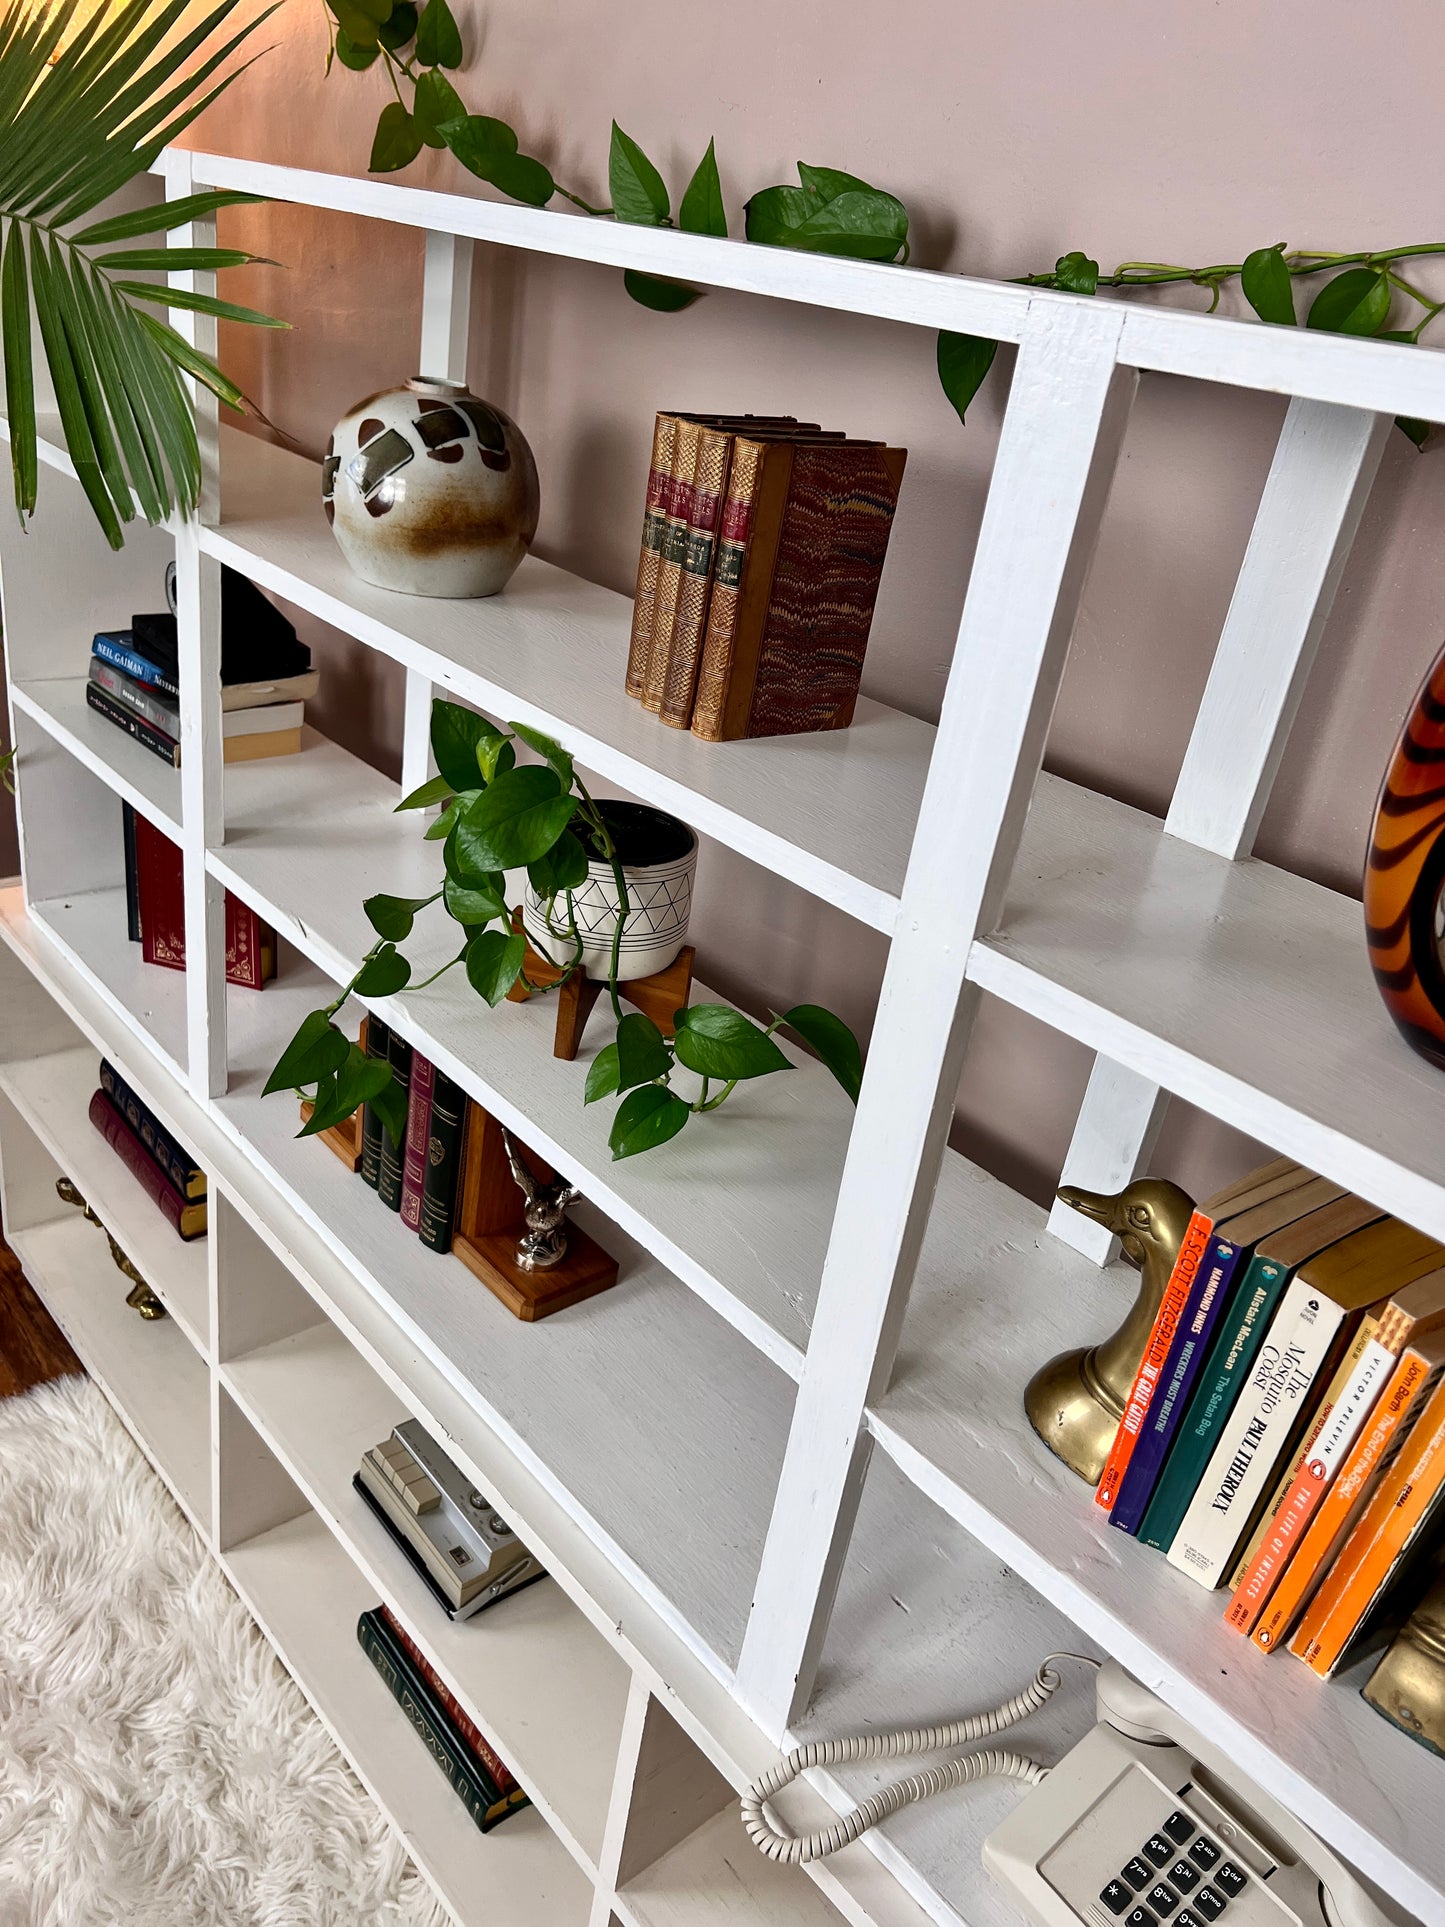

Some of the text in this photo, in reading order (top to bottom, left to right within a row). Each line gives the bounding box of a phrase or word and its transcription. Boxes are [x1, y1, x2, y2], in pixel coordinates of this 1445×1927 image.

[97, 642, 113, 659] NEIL
[115, 653, 143, 675] GAIMAN
[1123, 1227, 1207, 1436] F. SCOTT FITZGERALD THE GREAT GATSBY
[1154, 1267, 1223, 1433] HAMMOND INNES WRECKERS MUST BREATHE
[1195, 1286, 1267, 1436] Alistair MacLean The Satan Bug
[1253, 1345, 1280, 1391] Coast
[1261, 1341, 1306, 1414] Mosquito
[1402, 1362, 1422, 1387] John
[1285, 1368, 1313, 1399] The
[1353, 1358, 1380, 1401] VICTOR
[1388, 1385, 1410, 1412] Barth
[1324, 1406, 1353, 1455] PELEVIN
[1381, 1412, 1395, 1431] The
[1368, 1428, 1385, 1448] End
[1364, 1446, 1375, 1459] of
[1211, 1416, 1267, 1515] PAUL THEROUX
[1355, 1456, 1369, 1475] the
[1395, 1484, 1413, 1508] EMMA
[1247, 1487, 1311, 1599] THE LIFE OF INSECTS
[1170, 1815, 1178, 1824] 1
[1150, 1840, 1169, 1854] 4 ghi
[1194, 1841, 1216, 1858] 2 abc
[1129, 1861, 1147, 1877] 7 prs
[1174, 1864, 1193, 1879] 5 jkl
[1221, 1866, 1242, 1883] 3 def
[1153, 1887, 1172, 1903] 8 tuv
[1200, 1890, 1222, 1908] 6 mno
[1133, 1910, 1143, 1921] 0
[1179, 1913, 1189, 1924] 9
